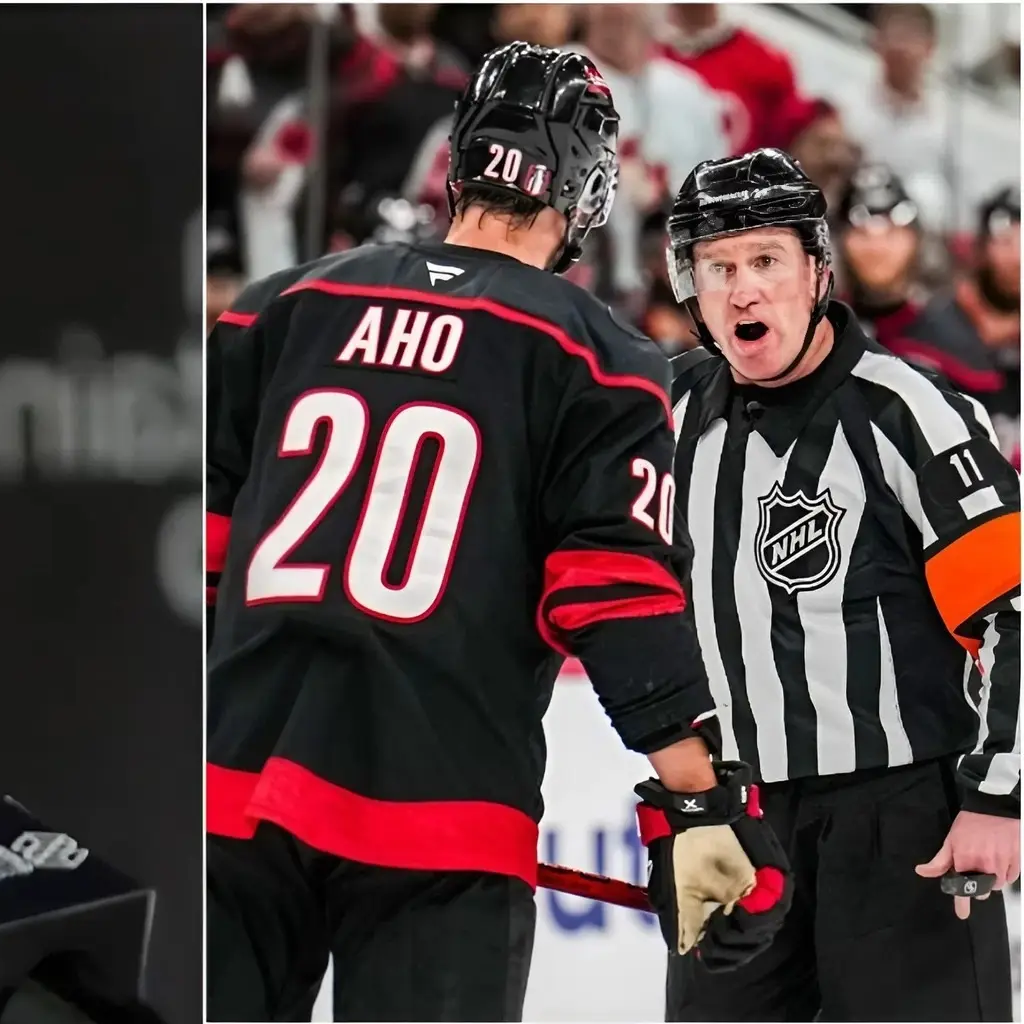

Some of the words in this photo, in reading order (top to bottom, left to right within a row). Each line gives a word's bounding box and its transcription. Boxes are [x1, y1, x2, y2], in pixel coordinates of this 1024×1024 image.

[484, 144, 522, 182] 20
[335, 305, 465, 374] AHO
[949, 448, 984, 488] 11
[245, 386, 483, 625] 20
[630, 457, 677, 546] 20
[771, 519, 823, 566] NHL
